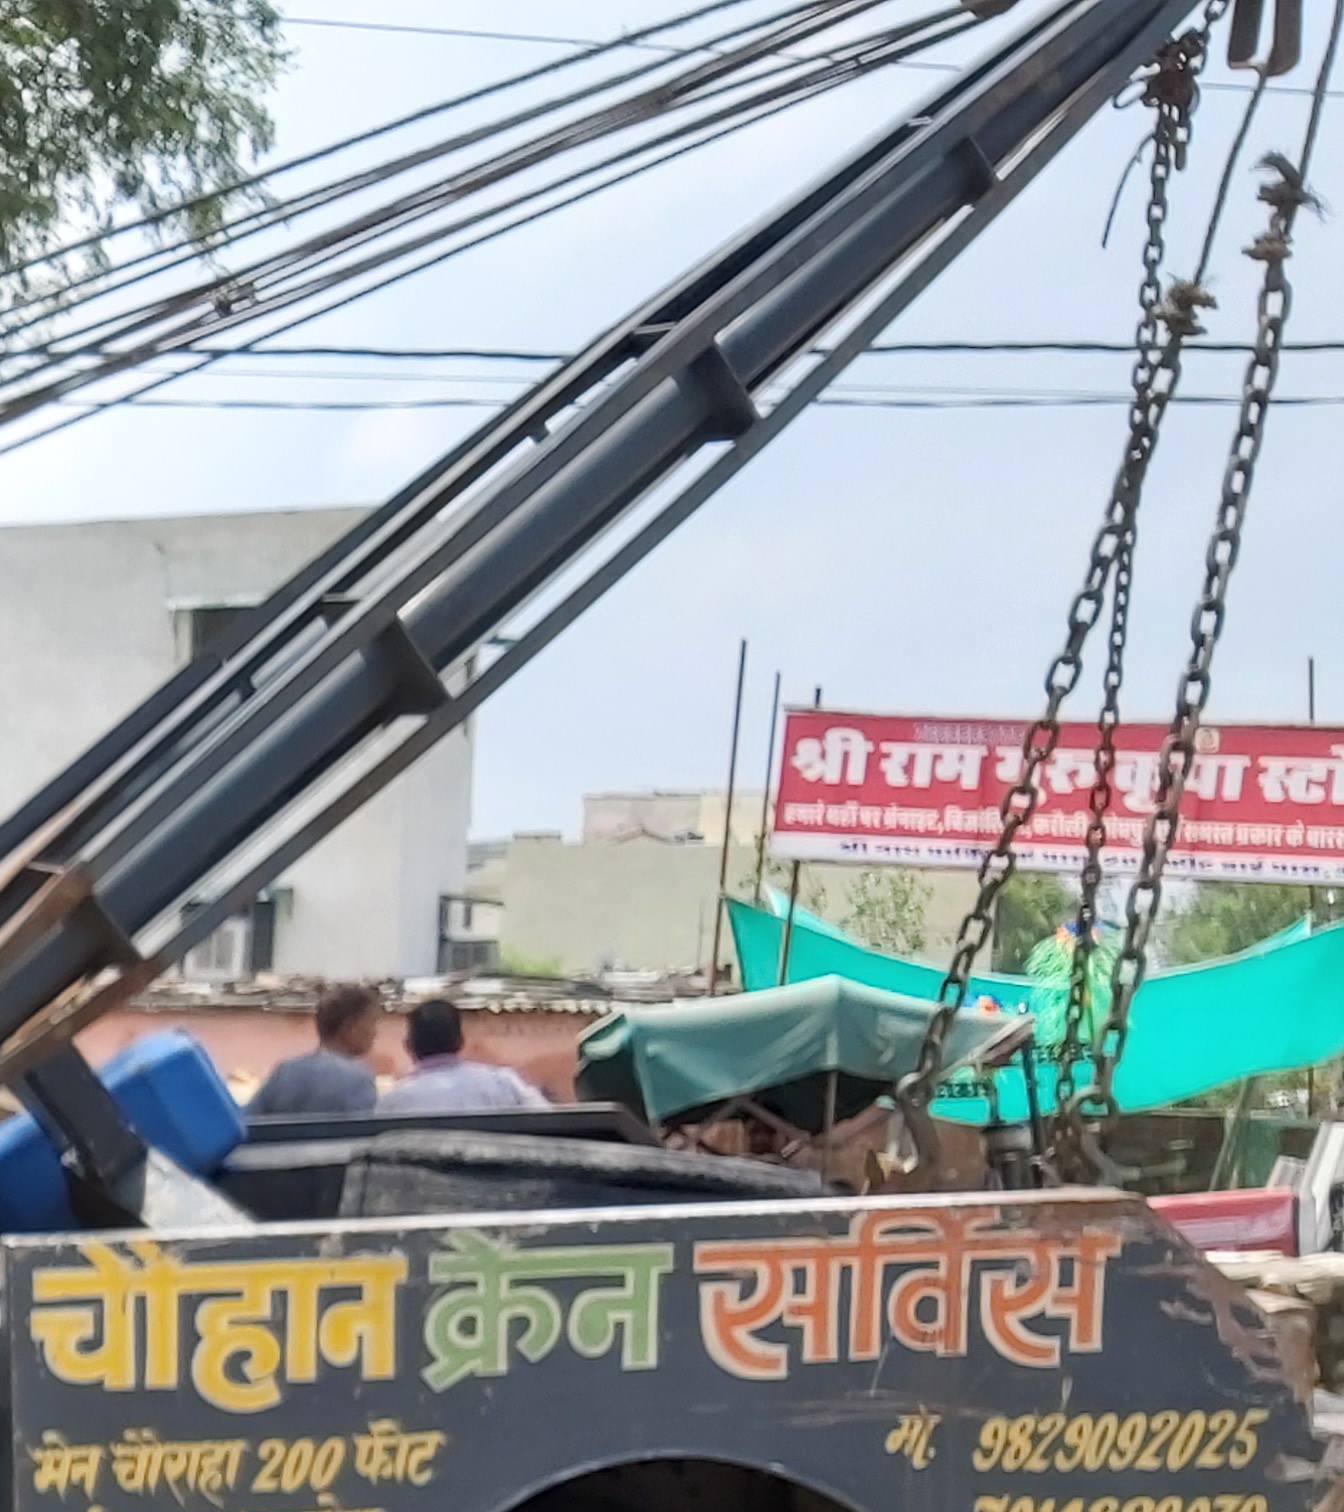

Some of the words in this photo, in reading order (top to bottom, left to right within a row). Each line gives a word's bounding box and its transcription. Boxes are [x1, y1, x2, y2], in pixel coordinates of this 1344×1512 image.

[790, 727, 875, 786] श्री
[879, 741, 989, 790] राम
[29, 1238, 409, 1414] चौहान
[420, 1228, 674, 1394] क्रेन
[250, 1436, 347, 1494] 200
[972, 1407, 1271, 1474] 9829092025
